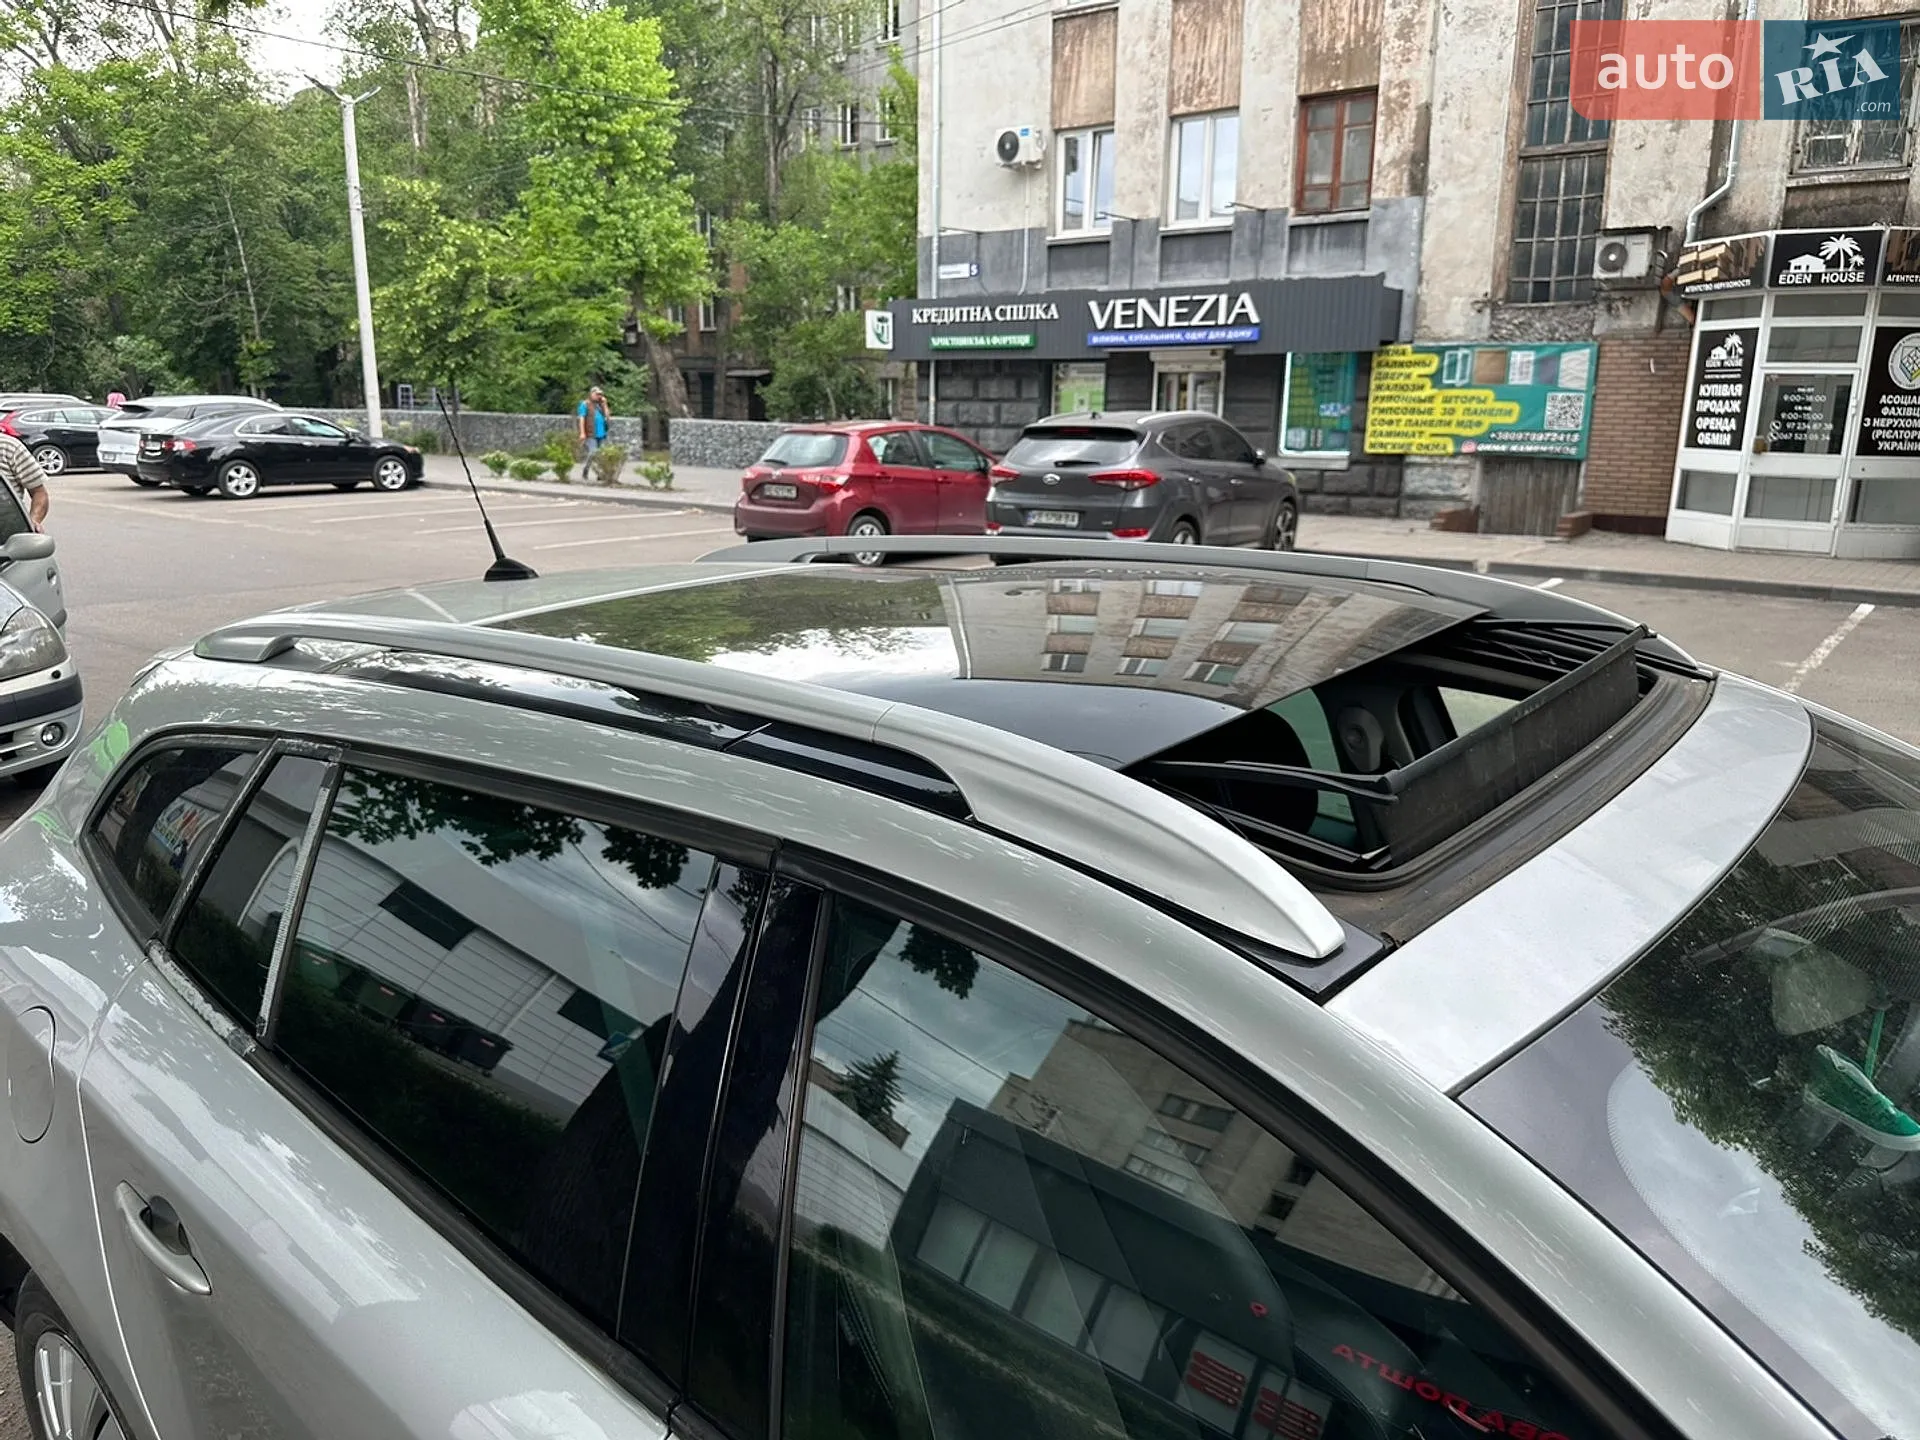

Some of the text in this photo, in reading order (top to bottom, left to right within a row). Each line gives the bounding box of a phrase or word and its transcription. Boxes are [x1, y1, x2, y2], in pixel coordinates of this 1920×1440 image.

[1778, 271, 1865, 284] EDEN HOUSE
[911, 302, 1060, 325] КРЕДИТНА СПІЛКА
[1087, 292, 1261, 330] VENEZIA
[1698, 383, 1743, 397] КУПІВЛЯ
[1695, 399, 1742, 415] ПРОДАЖ
[1695, 416, 1737, 432] ОРЕНДА
[1697, 432, 1732, 446] ОБМІН
